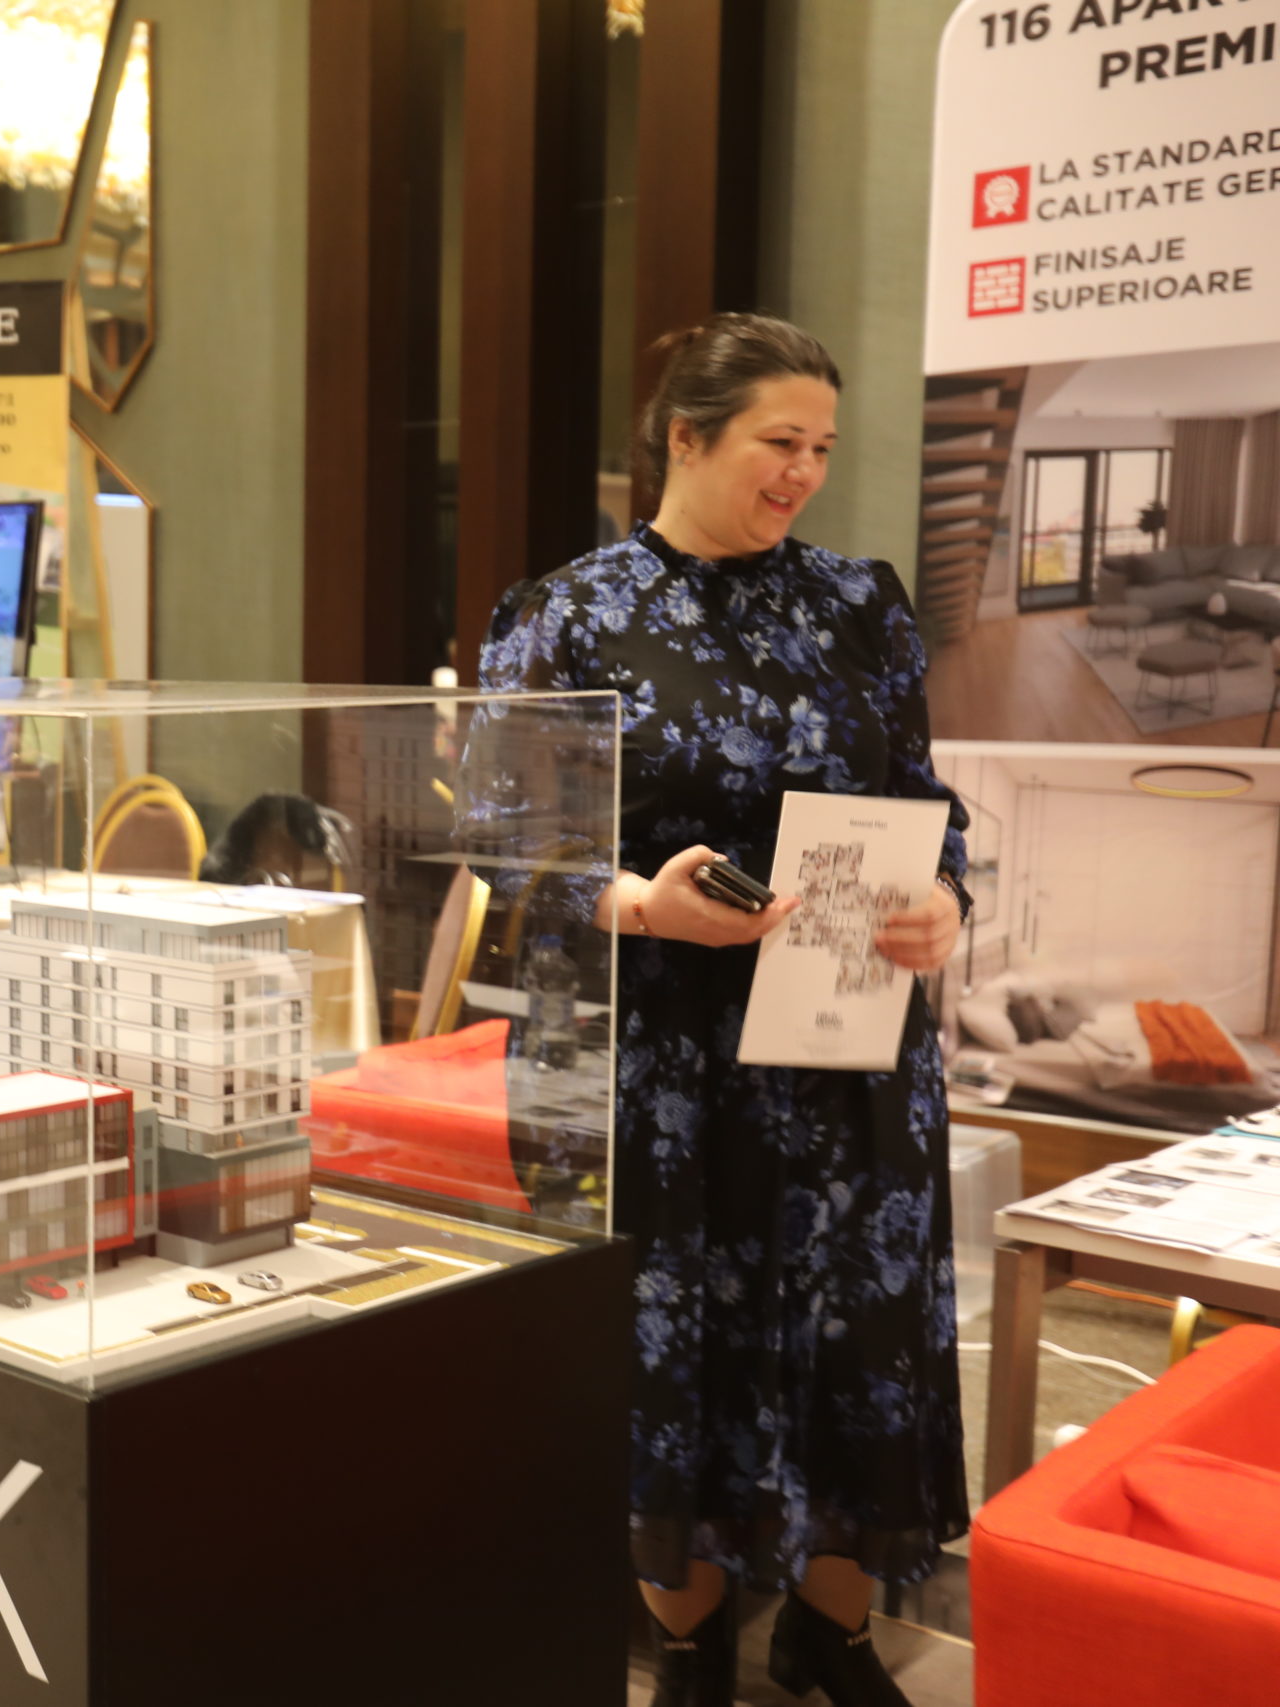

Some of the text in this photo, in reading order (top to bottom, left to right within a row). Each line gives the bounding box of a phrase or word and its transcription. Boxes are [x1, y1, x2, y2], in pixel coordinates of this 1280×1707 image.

[980, 3, 1051, 48] 116
[1099, 22, 1276, 89] PREMI
[1039, 159, 1080, 185] LA
[1036, 178, 1205, 222] CALITATE
[1034, 237, 1186, 277] FINISAJE
[1032, 267, 1253, 314] SUPERIOARE
